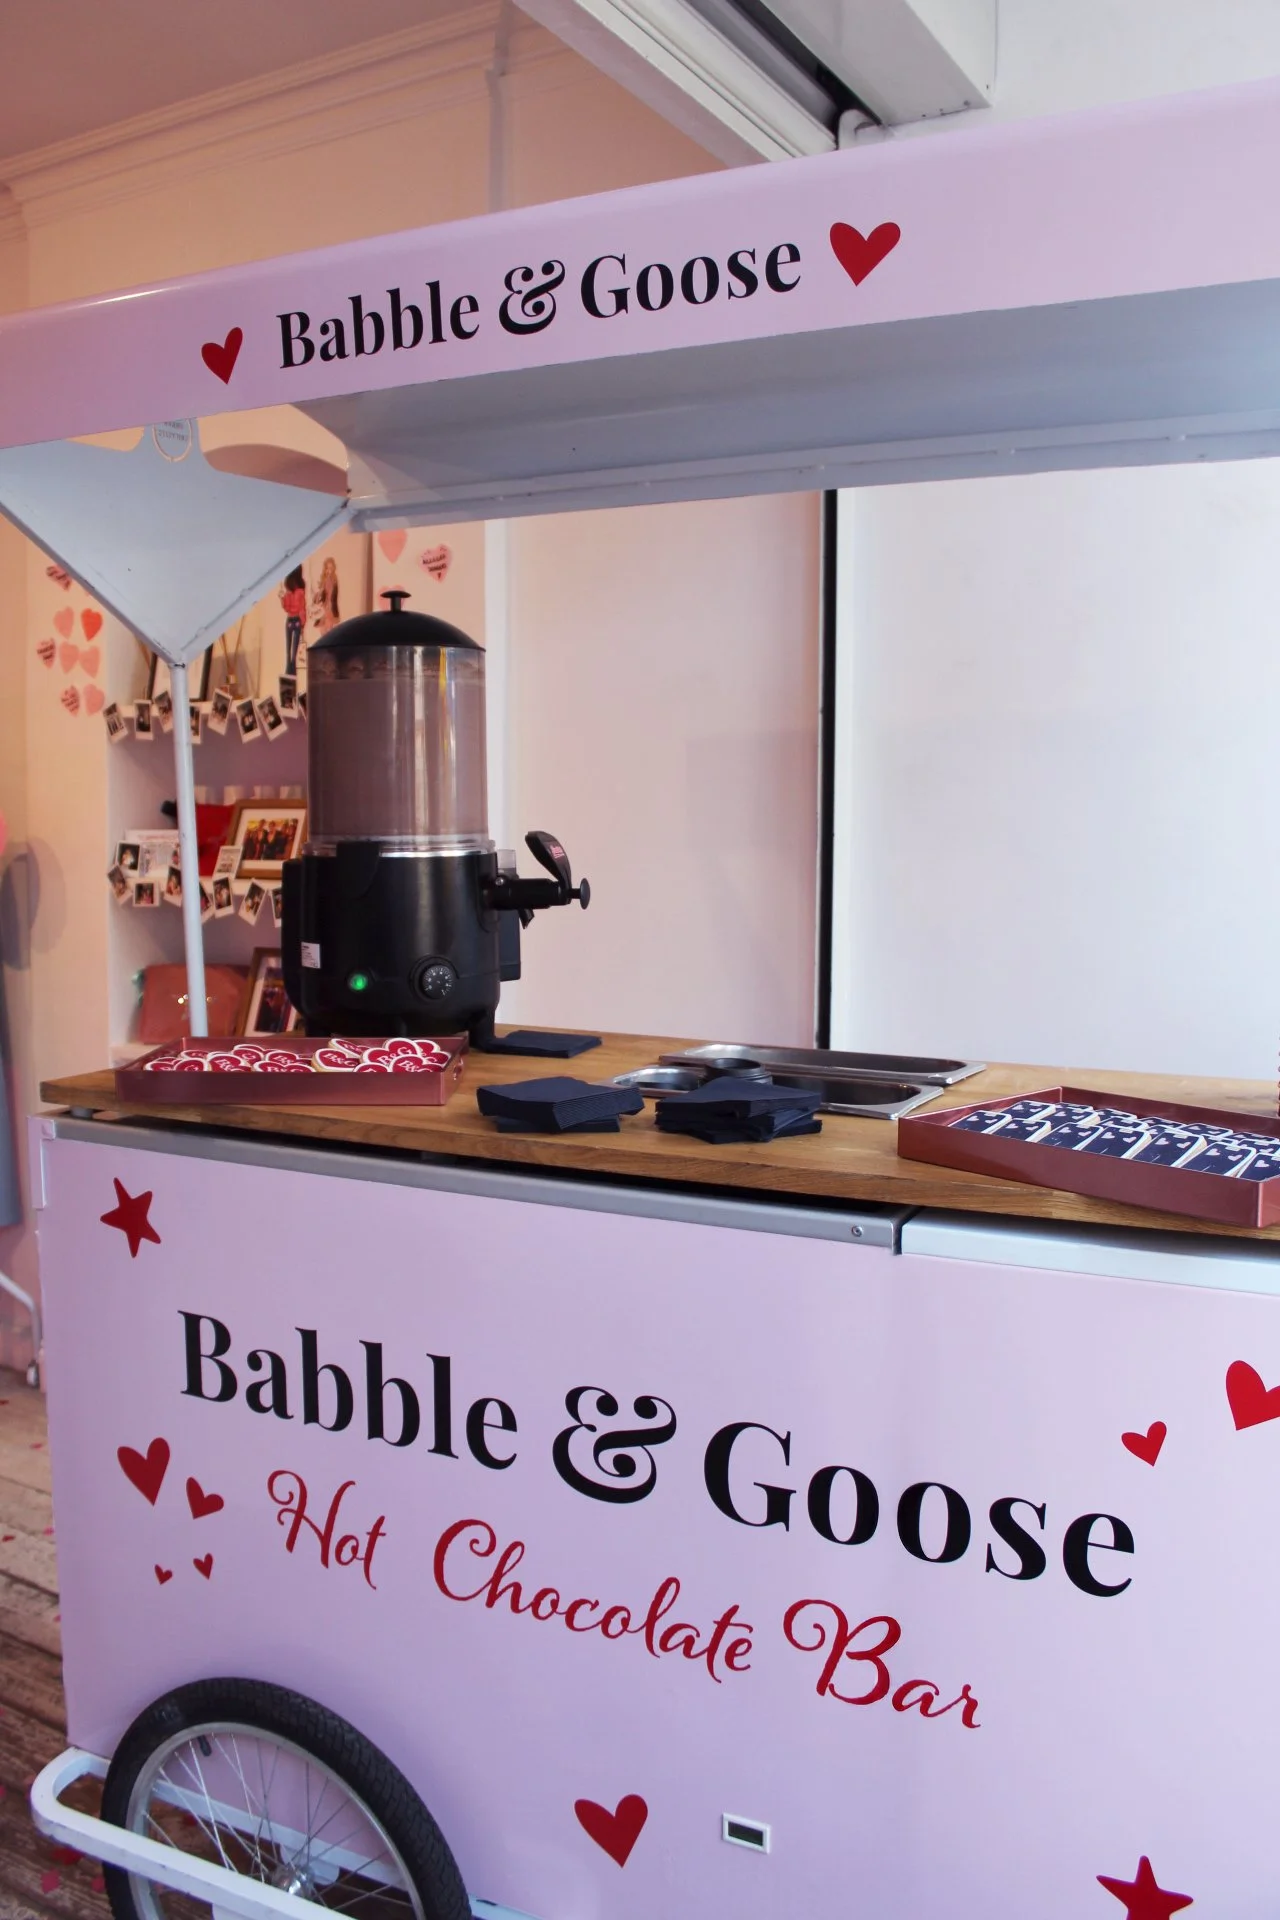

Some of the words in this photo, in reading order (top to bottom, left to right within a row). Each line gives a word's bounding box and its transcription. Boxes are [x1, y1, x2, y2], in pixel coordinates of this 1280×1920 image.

[275, 279, 480, 369] Babble
[498, 259, 566, 336] &
[580, 243, 801, 319] Goose
[177, 1310, 518, 1471] Babble
[552, 1385, 677, 1504] &
[703, 1421, 1135, 1598] Goose
[267, 1470, 386, 1590] Hot
[433, 1518, 753, 1683] Chocolate
[783, 1598, 982, 1730] Bar
